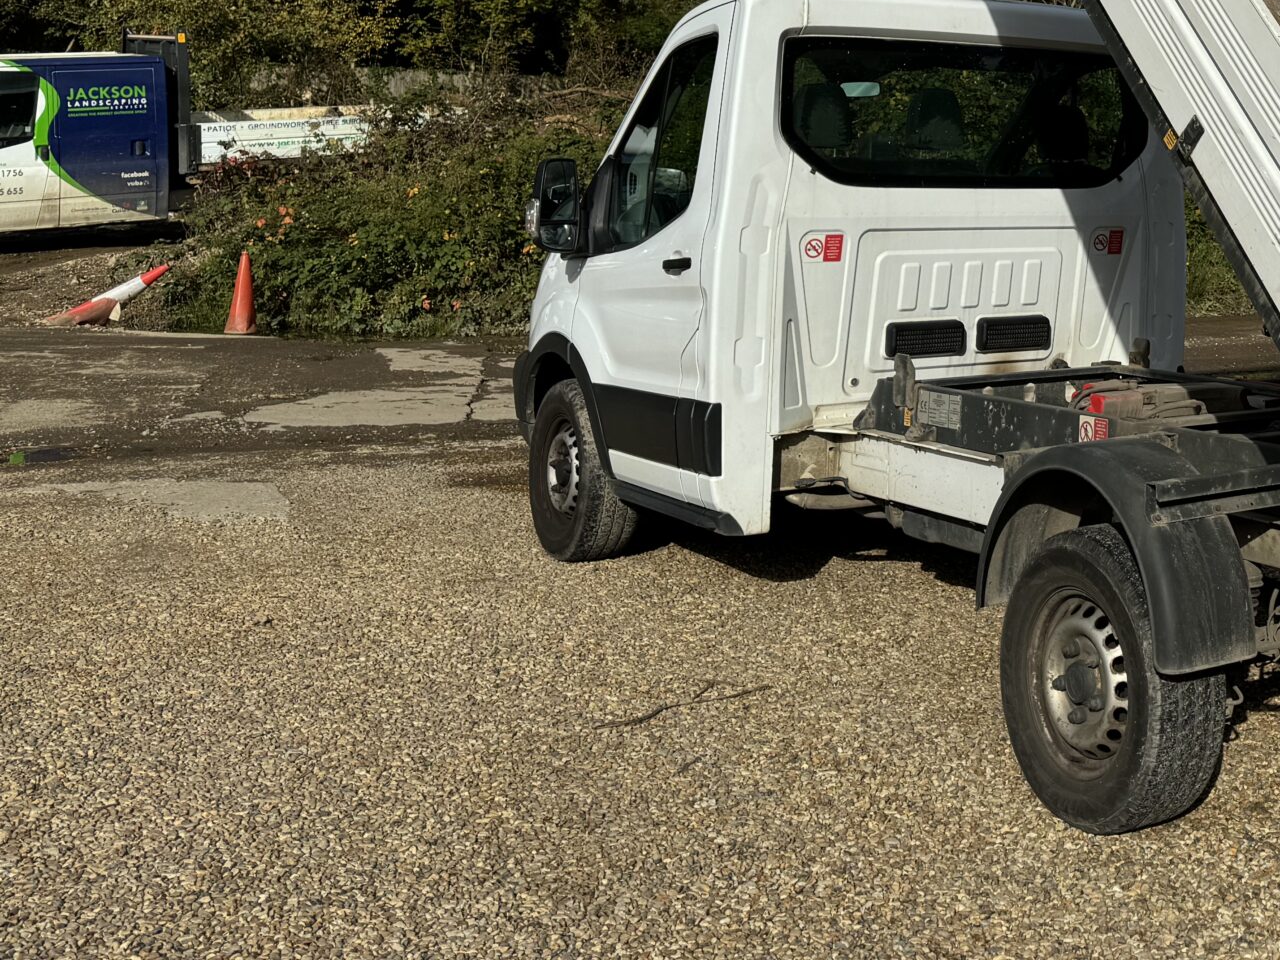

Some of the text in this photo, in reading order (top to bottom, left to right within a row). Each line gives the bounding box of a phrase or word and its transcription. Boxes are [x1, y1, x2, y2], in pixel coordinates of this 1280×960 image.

[66, 85, 146, 100] JACKSON
[67, 98, 147, 107] LANDSCAPING
[207, 124, 237, 133] PATIOS
[248, 121, 310, 131] GROUNDWORKS
[121, 170, 149, 178] facebook
